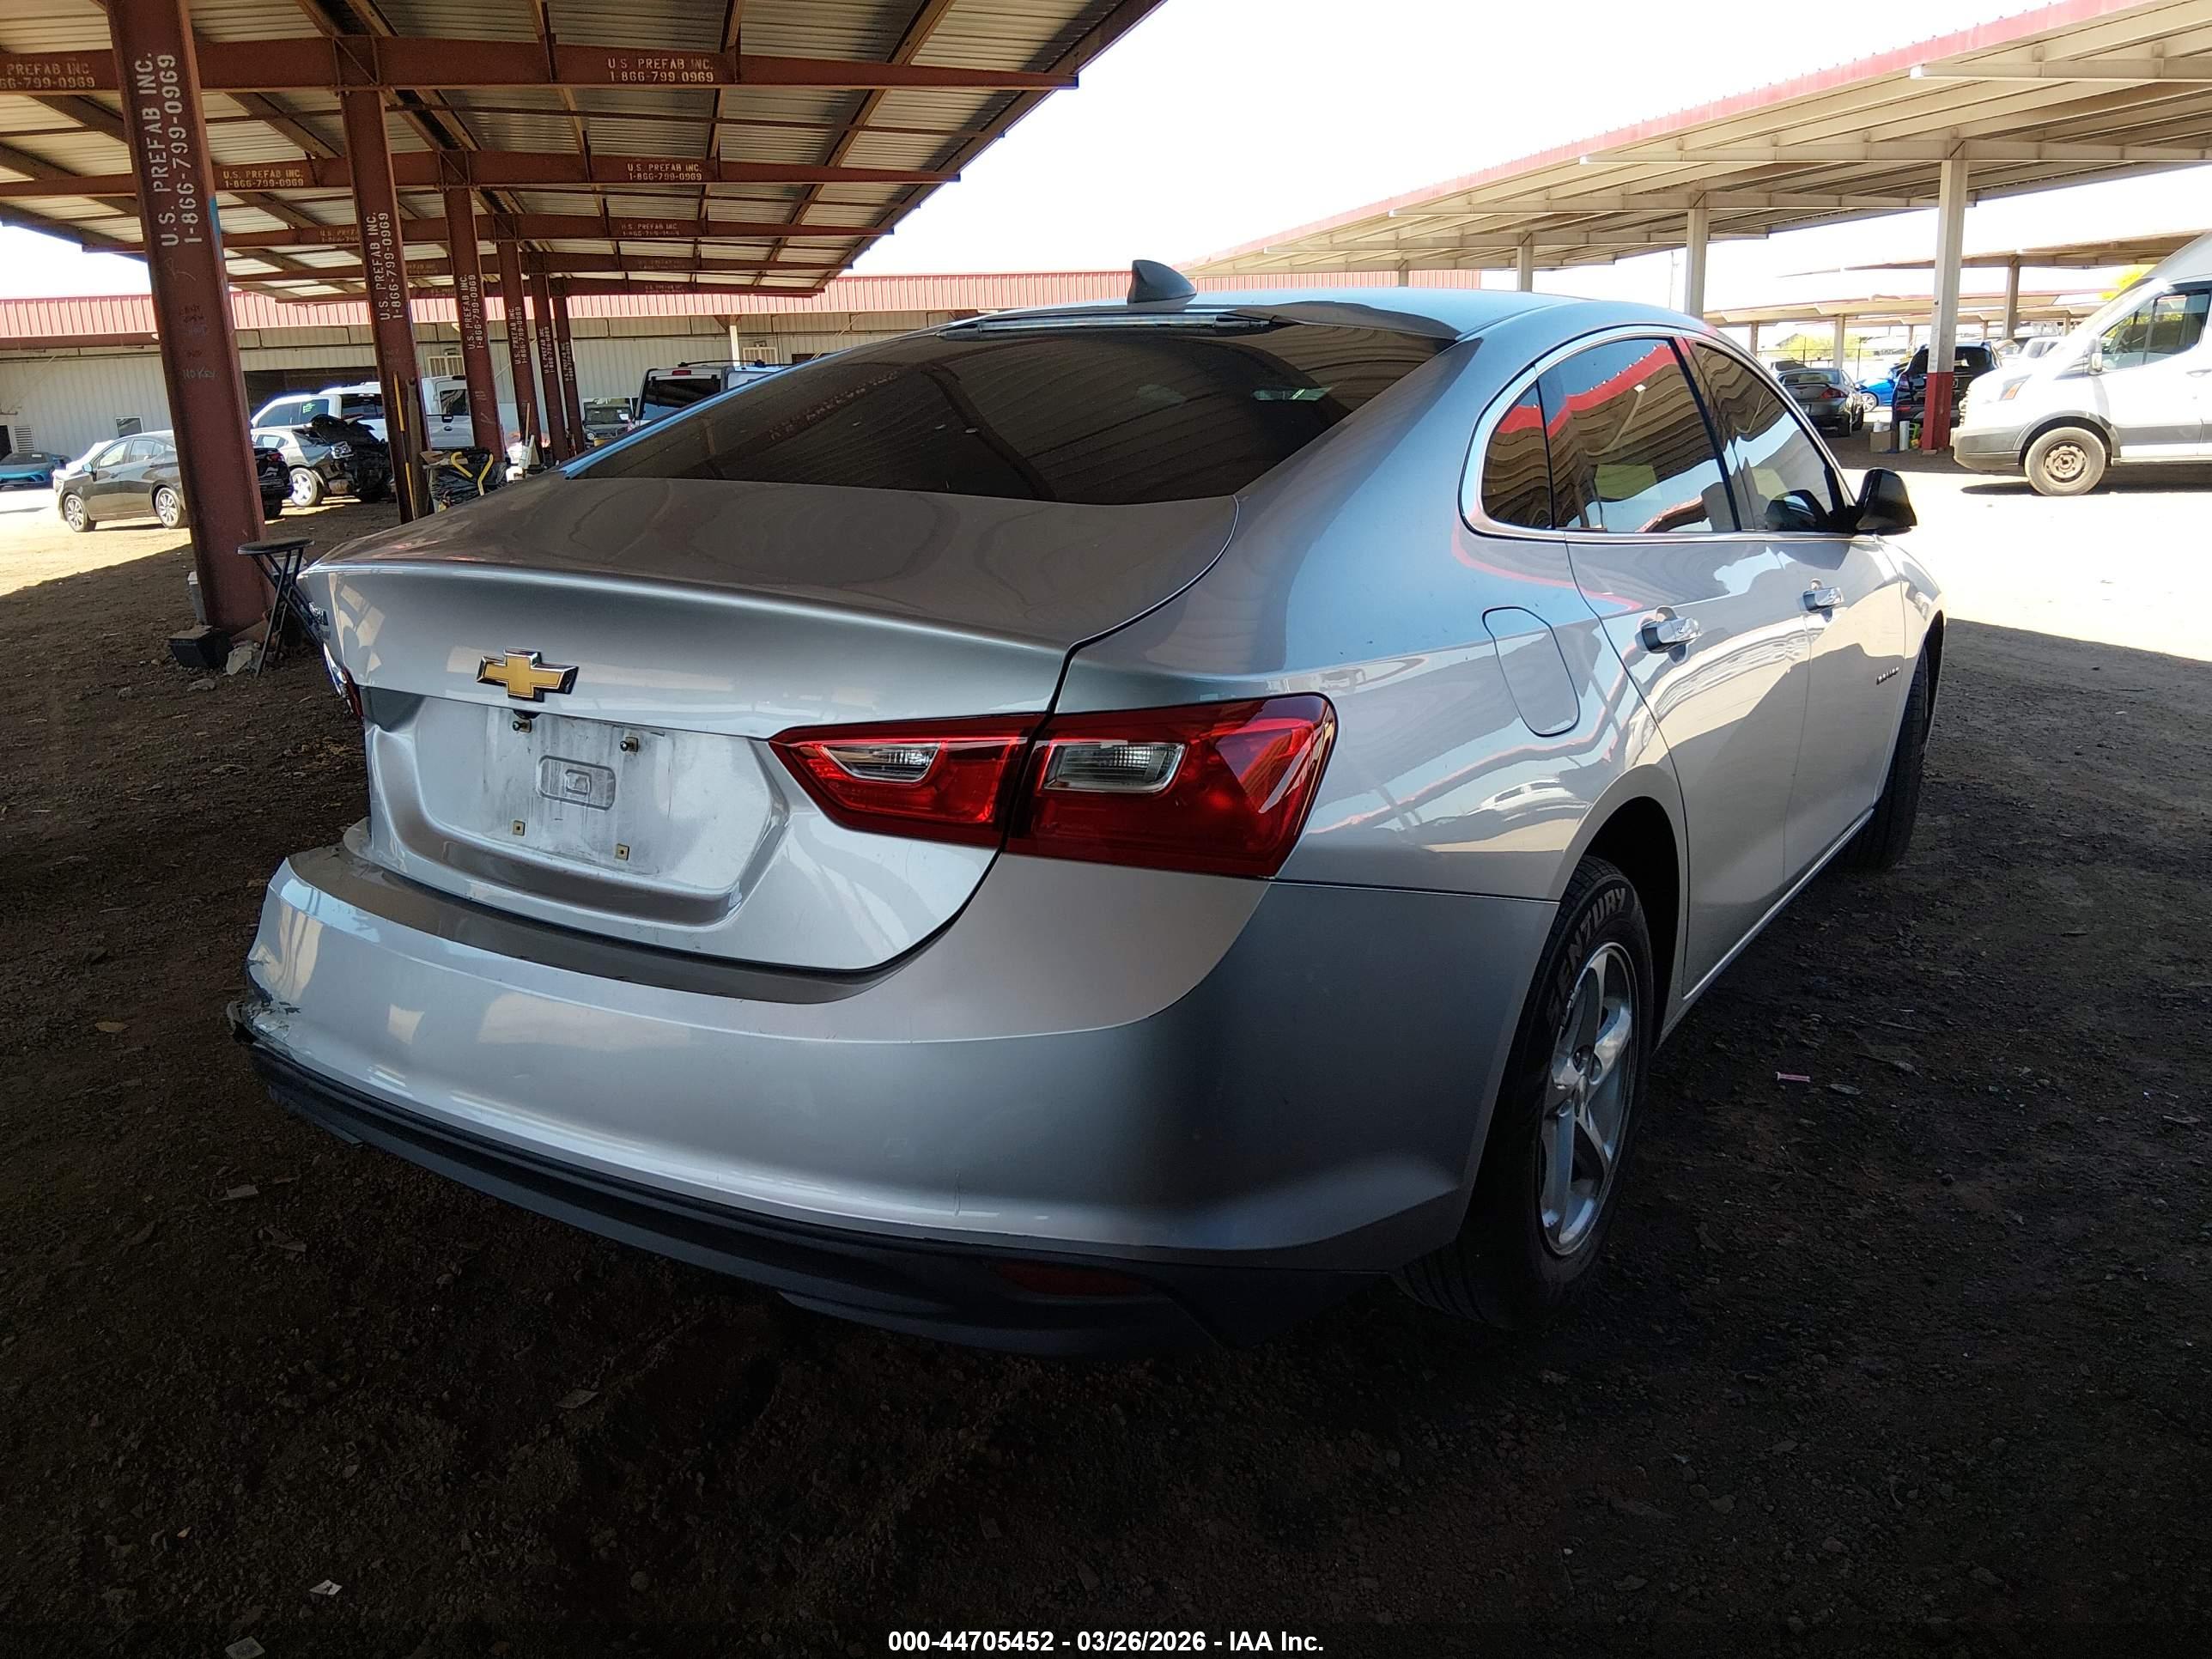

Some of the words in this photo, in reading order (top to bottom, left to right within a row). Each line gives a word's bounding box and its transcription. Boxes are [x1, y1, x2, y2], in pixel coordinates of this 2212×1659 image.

[6, 63, 61, 76] PREFAB
[135, 52, 157, 94] INC.
[638, 58, 685, 70] PREFAB
[142, 107, 173, 192] PREFAB
[156, 54, 203, 244] 1-866-799-0969
[223, 171, 241, 179] U.S.
[246, 170, 282, 179] PREFAB
[285, 169, 304, 179] INC.
[648, 163, 682, 173] PREFAB
[685, 163, 702, 173] INC.
[158, 205, 179, 246] U.S.
[366, 212, 379, 236] INC.
[369, 242, 386, 290] PREFAB
[378, 212, 404, 319] 1-866-799-0969
[459, 274, 469, 291] INC.
[378, 296, 391, 320] U.S.
[461, 295, 474, 329] PREFAB
